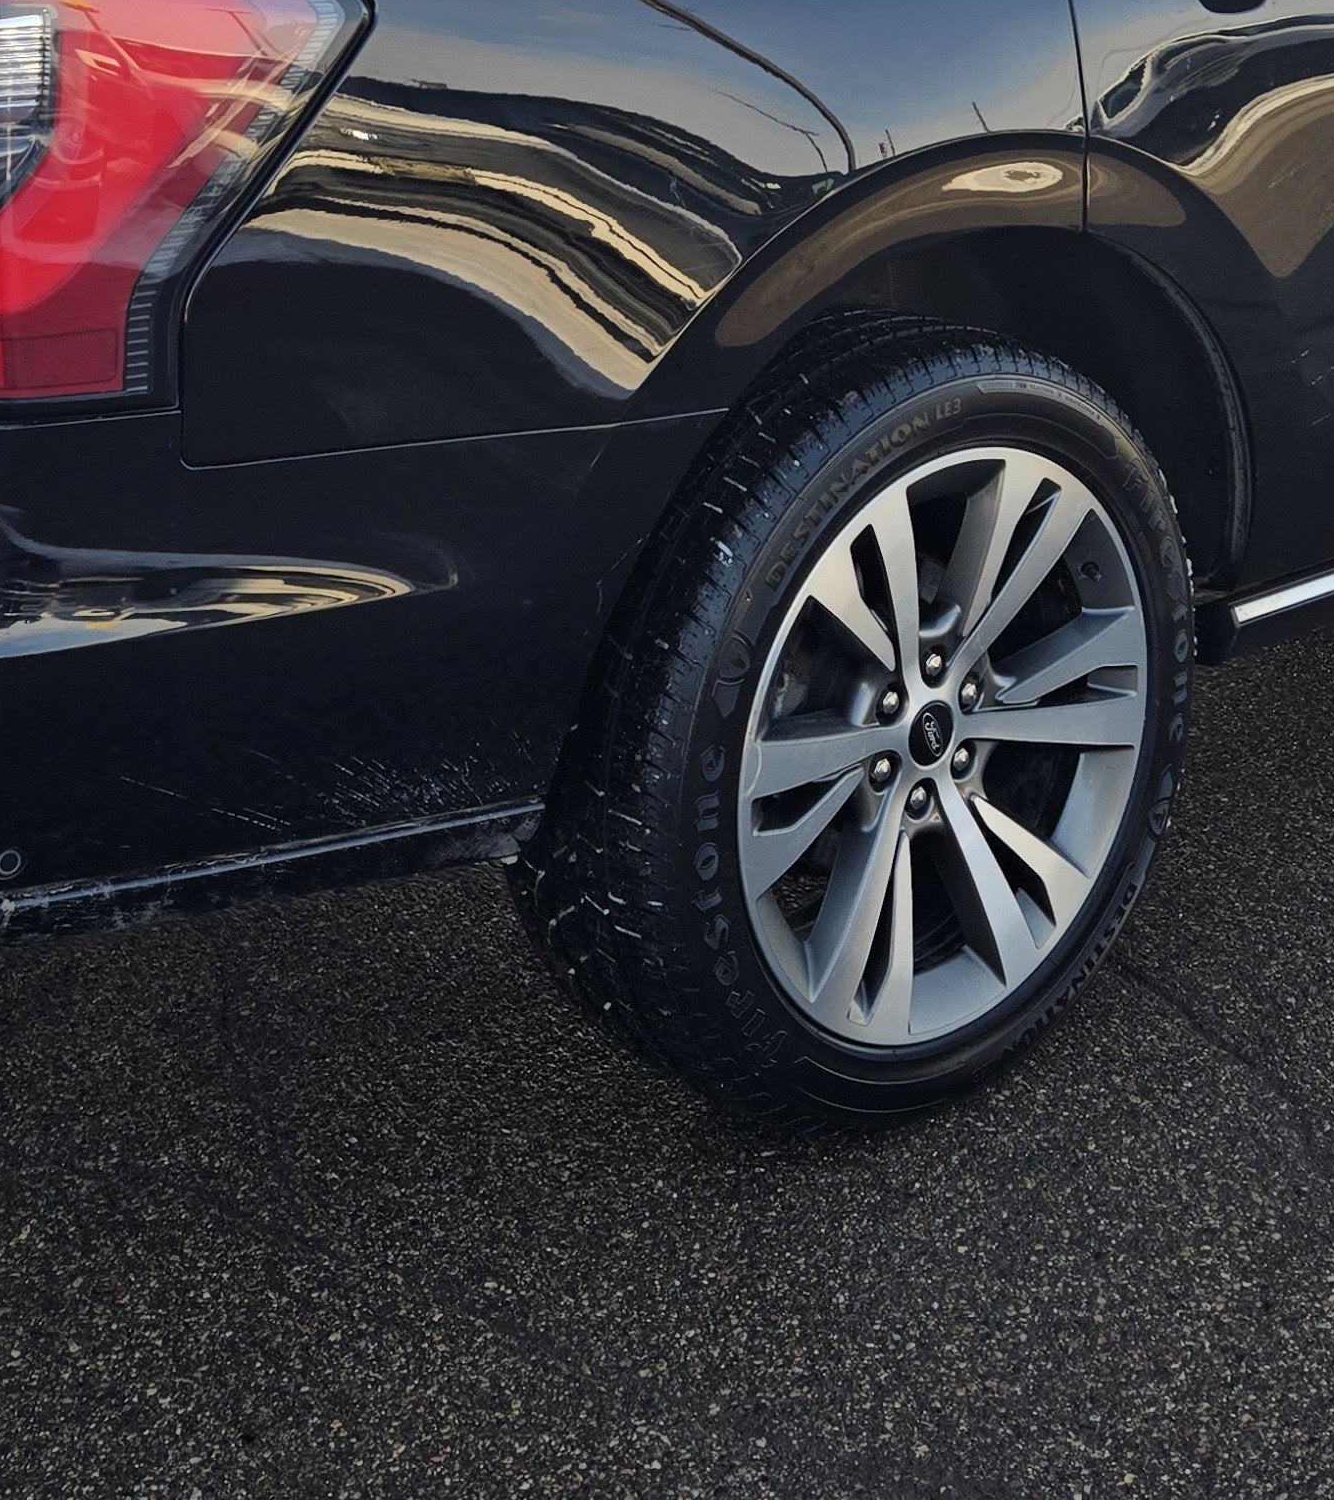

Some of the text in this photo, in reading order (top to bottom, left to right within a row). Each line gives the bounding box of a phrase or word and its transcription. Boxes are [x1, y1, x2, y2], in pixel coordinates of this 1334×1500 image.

[764, 398, 963, 589] DESTINATION LE3
[924, 721, 941, 751] Ford
[693, 745, 788, 1067] Firestone
